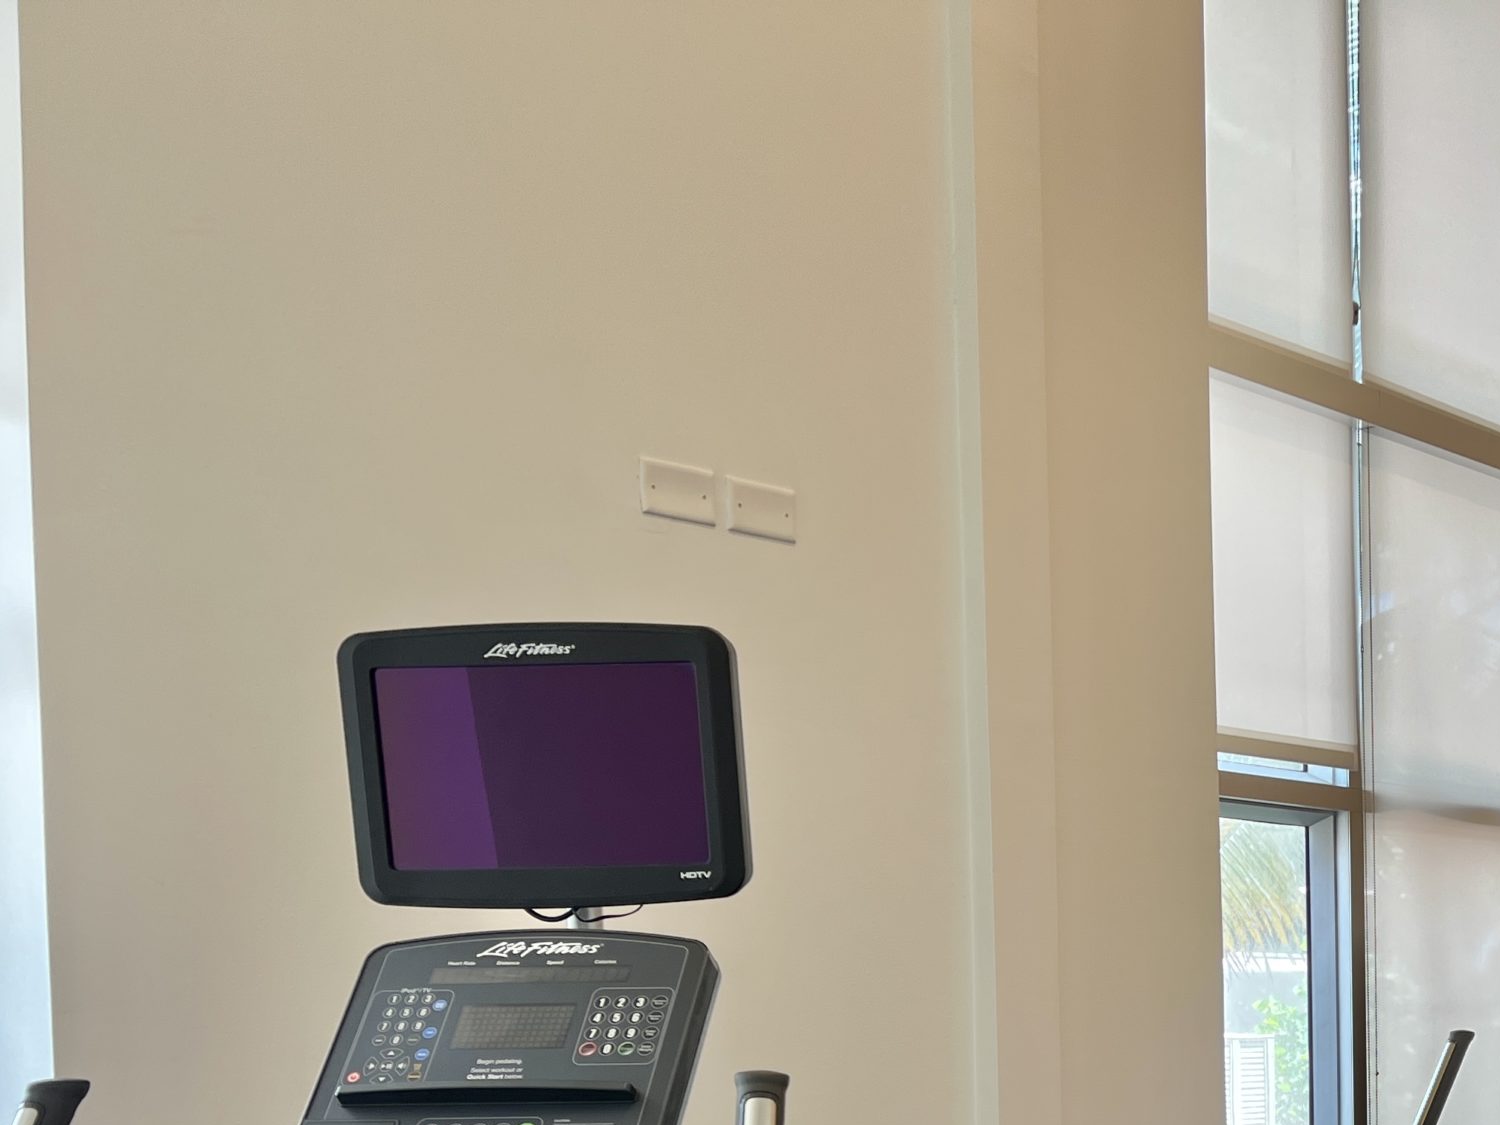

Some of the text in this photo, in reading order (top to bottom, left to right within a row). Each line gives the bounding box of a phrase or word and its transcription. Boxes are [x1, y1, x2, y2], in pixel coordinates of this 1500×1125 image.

[680, 871, 711, 879] HDTV
[392, 994, 433, 1003] 1 2 3
[599, 997, 606, 1007] 1
[617, 997, 626, 1007] 2
[635, 997, 645, 1007] 3
[593, 1013, 602, 1023] 4
[612, 1013, 621, 1023] 5
[631, 1012, 641, 1023] 6
[589, 1028, 597, 1039] 7
[607, 1028, 617, 1038] 8
[626, 1028, 636, 1038] 9
[602, 1043, 612, 1054] 0
